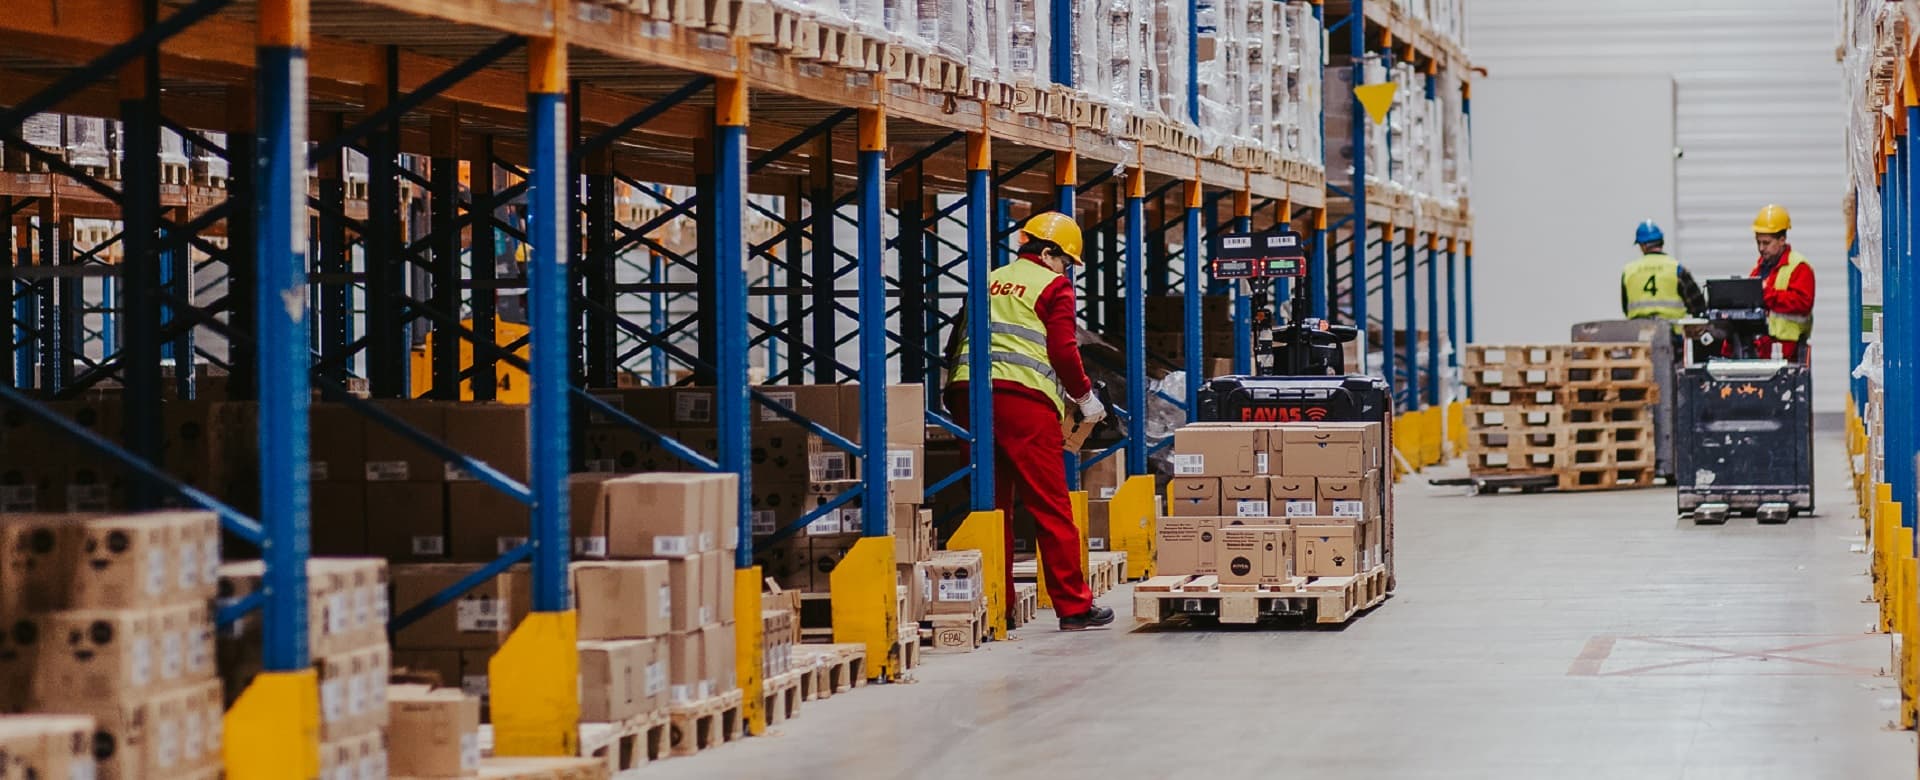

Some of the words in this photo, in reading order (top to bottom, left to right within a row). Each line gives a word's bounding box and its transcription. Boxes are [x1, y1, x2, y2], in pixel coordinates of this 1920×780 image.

[989, 280, 1026, 298] ben
[1643, 274, 1658, 296] 4
[943, 632, 962, 643] EPAL
